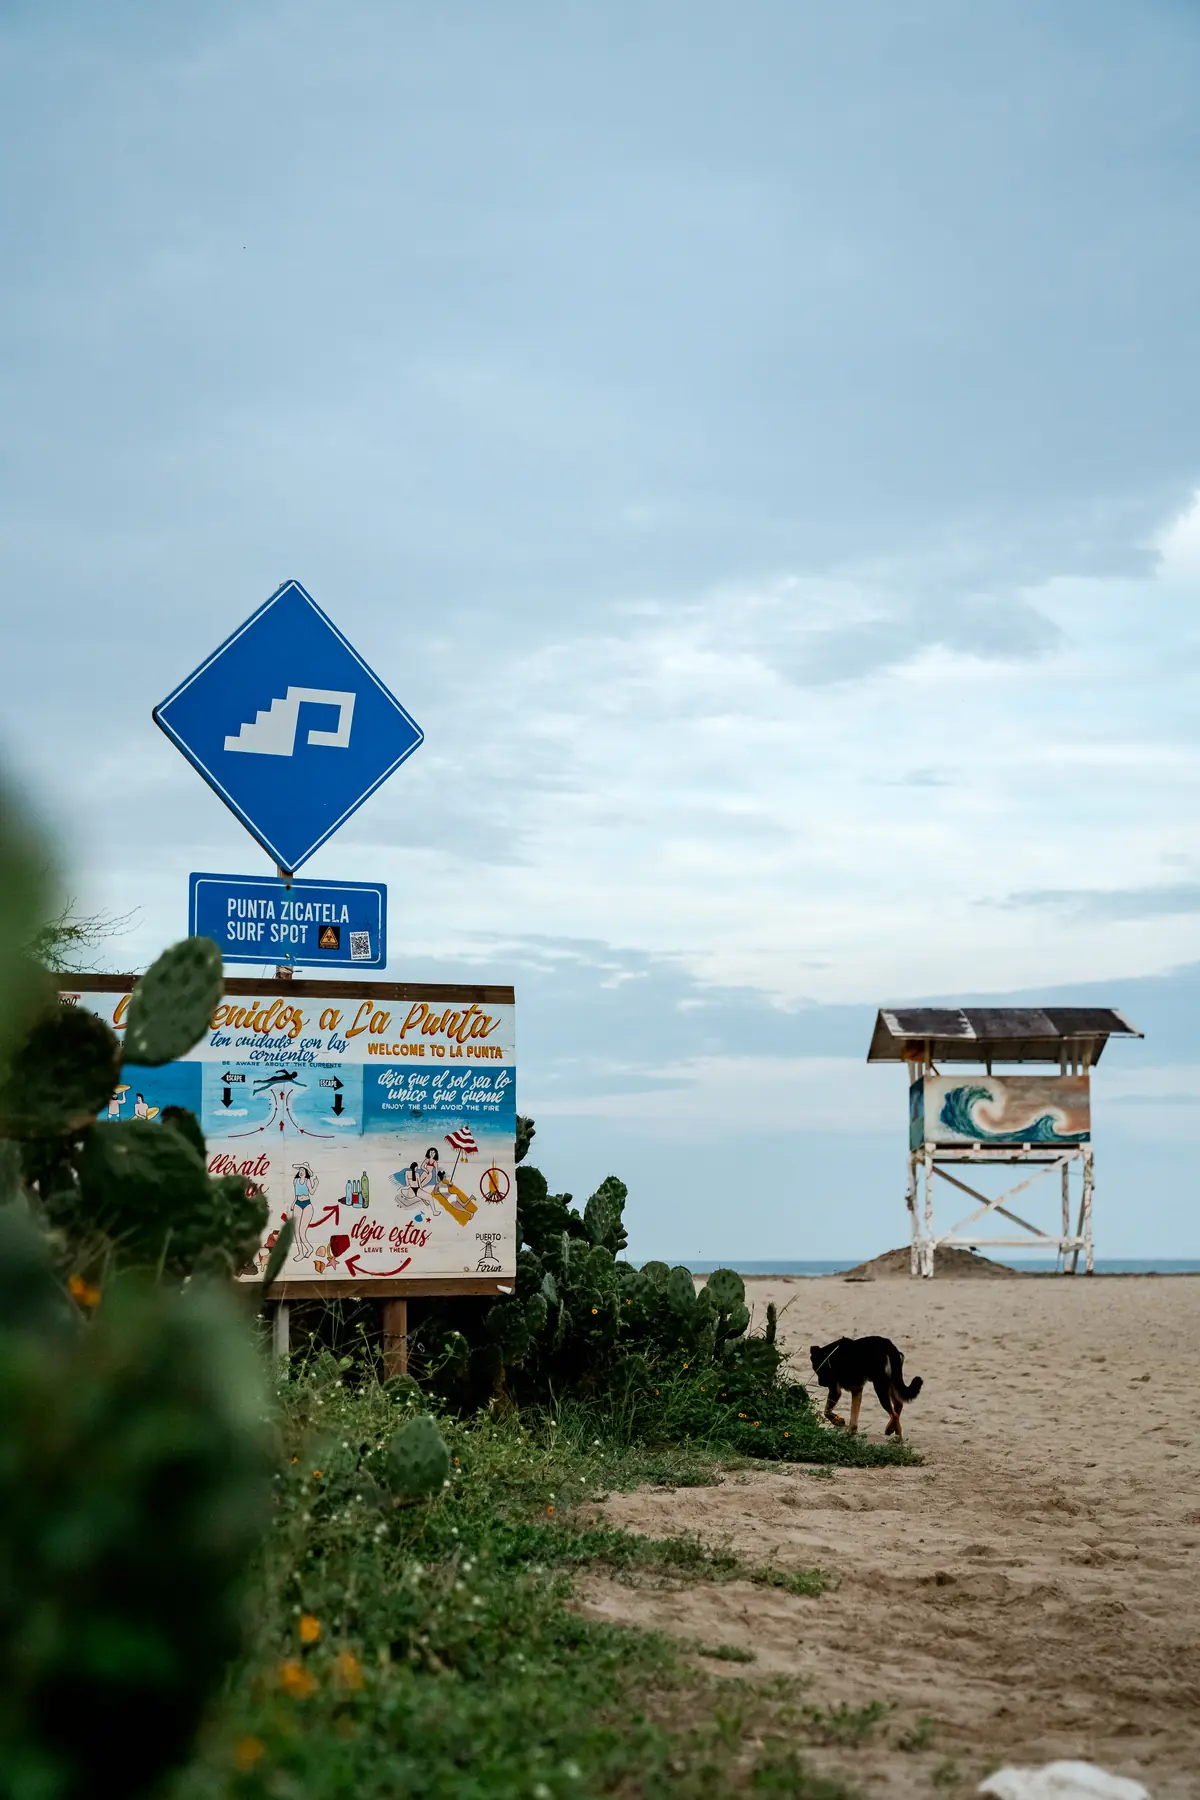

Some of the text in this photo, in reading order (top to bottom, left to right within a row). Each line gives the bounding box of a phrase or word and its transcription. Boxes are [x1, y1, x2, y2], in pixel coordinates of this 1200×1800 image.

[227, 898, 349, 923] PUNTA ZICATELA
[226, 921, 308, 944] SURF SPOT
[319, 1007, 344, 1031] a
[345, 1000, 392, 1038] La
[400, 1002, 501, 1044] Punta
[210, 1031, 350, 1053] ten cuidado con las
[368, 1043, 503, 1059] WELCOME TO LA PUNTA
[249, 1048, 319, 1063] corrientes
[226, 1074, 243, 1083] ESCAPE
[320, 1080, 337, 1088] ESCAPE
[378, 1069, 403, 1088] deja
[432, 1070, 450, 1086] el
[447, 1070, 472, 1089] sol
[470, 1075, 491, 1090] sea
[494, 1070, 512, 1089] lo
[351, 1215, 432, 1247] deja estas
[475, 1233, 502, 1241] PUERTO
